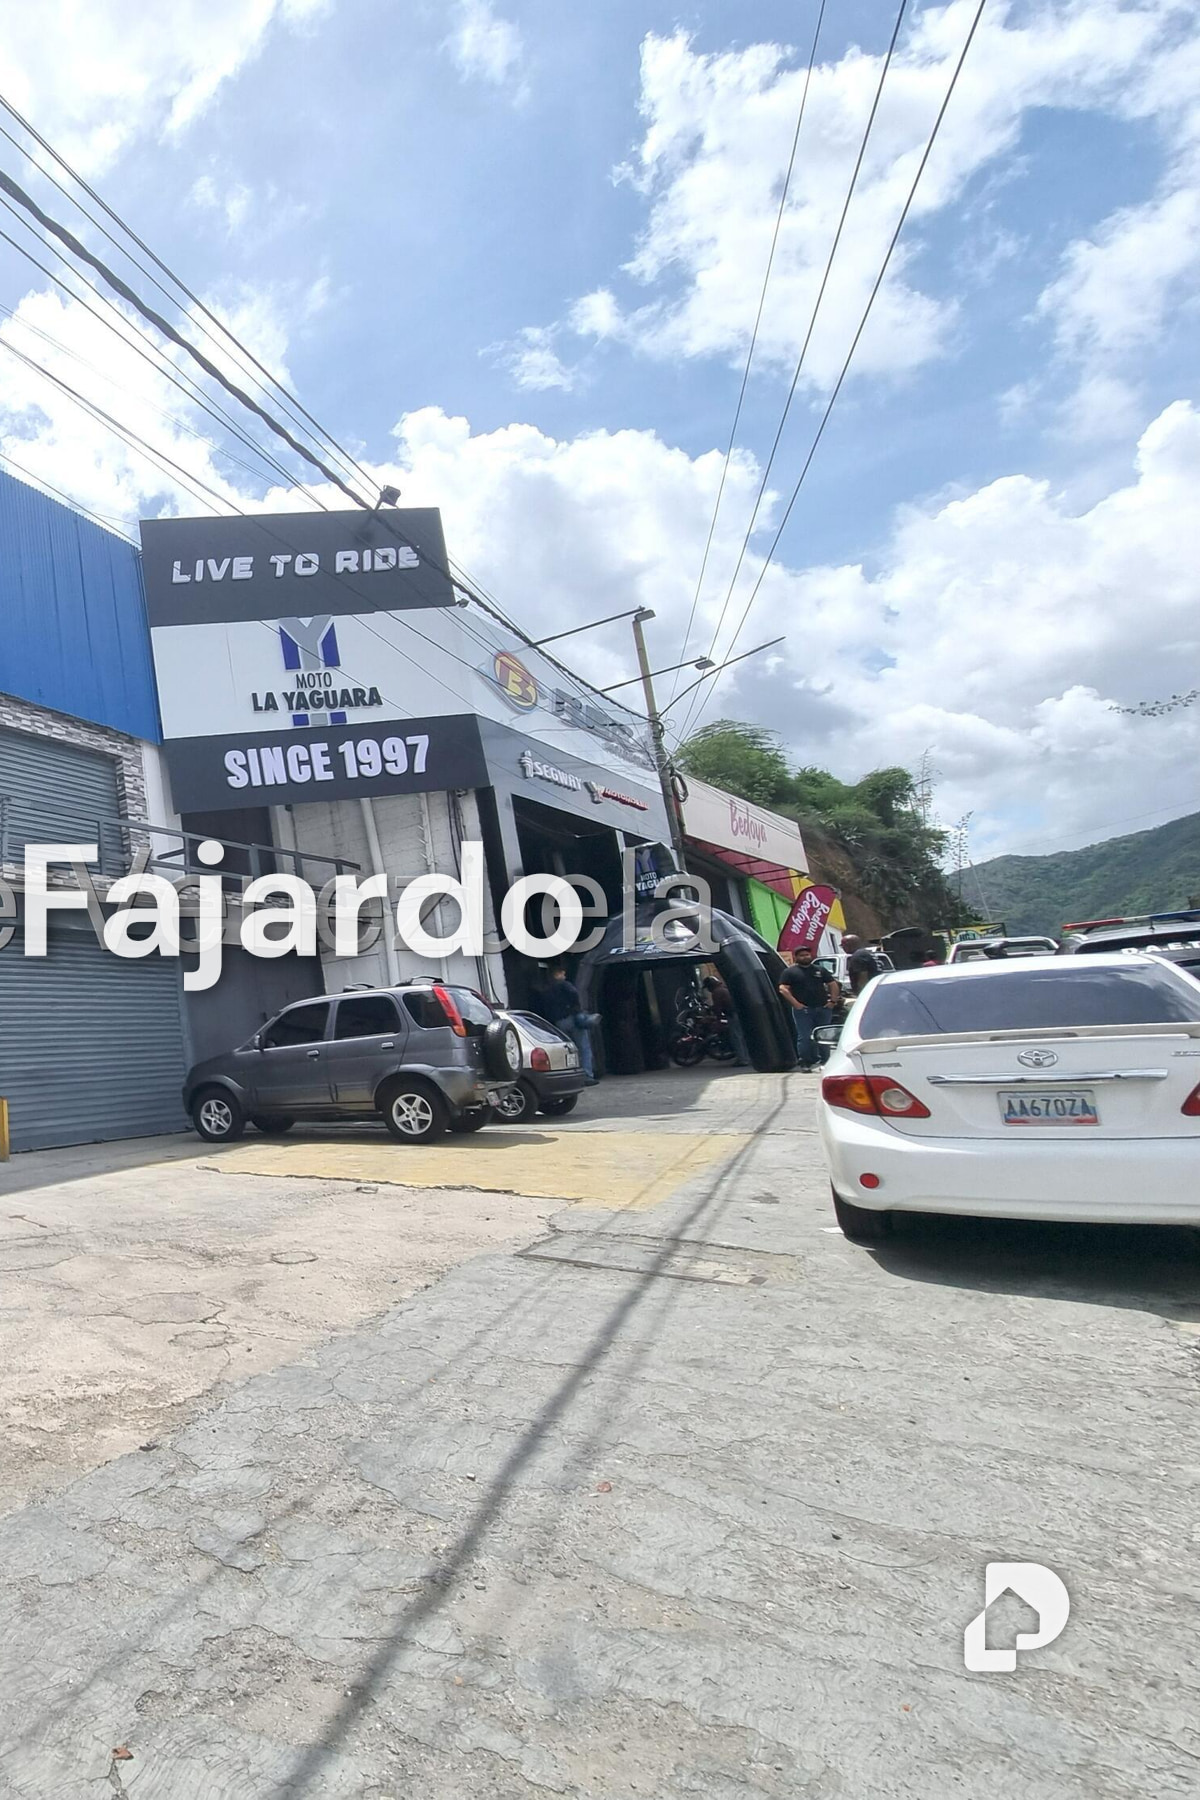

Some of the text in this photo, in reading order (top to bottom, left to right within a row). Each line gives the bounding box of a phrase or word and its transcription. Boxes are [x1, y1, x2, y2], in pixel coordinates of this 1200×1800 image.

[172, 546, 420, 583] LIVE TO RIDE
[295, 671, 332, 689] MOTO
[251, 686, 382, 712] LA YAGUARA
[224, 734, 430, 789] SINCE 1997
[533, 761, 582, 792] SEGWAY
[729, 799, 767, 848] Bedoya
